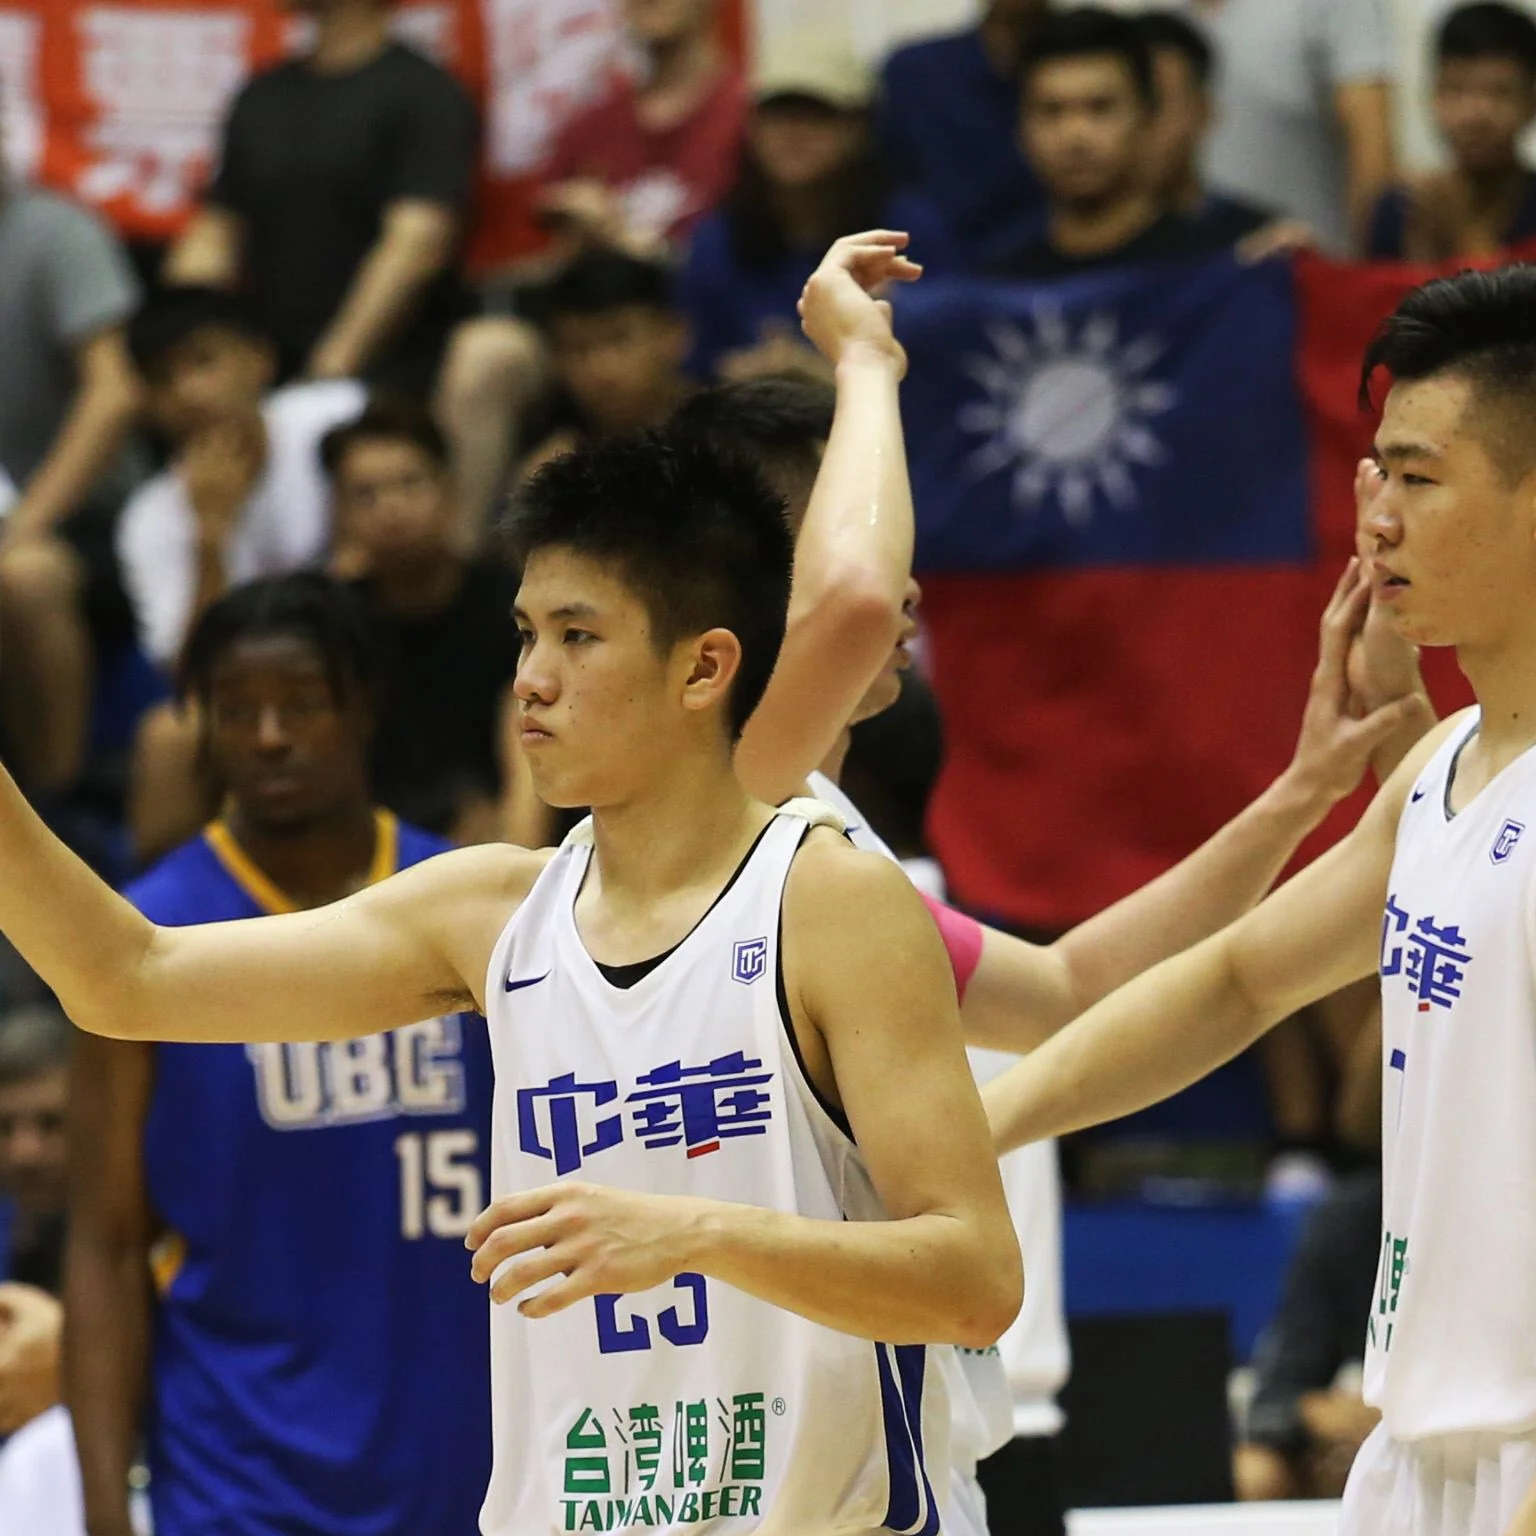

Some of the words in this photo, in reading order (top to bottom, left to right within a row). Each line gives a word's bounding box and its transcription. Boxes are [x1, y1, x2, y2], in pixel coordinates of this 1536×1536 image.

[245, 1015, 465, 1132] UBC
[517, 1050, 774, 1177] 中華
[394, 1129, 483, 1240] 15
[559, 1494, 675, 1531] TAIWAN
[677, 1486, 762, 1523] BEER
